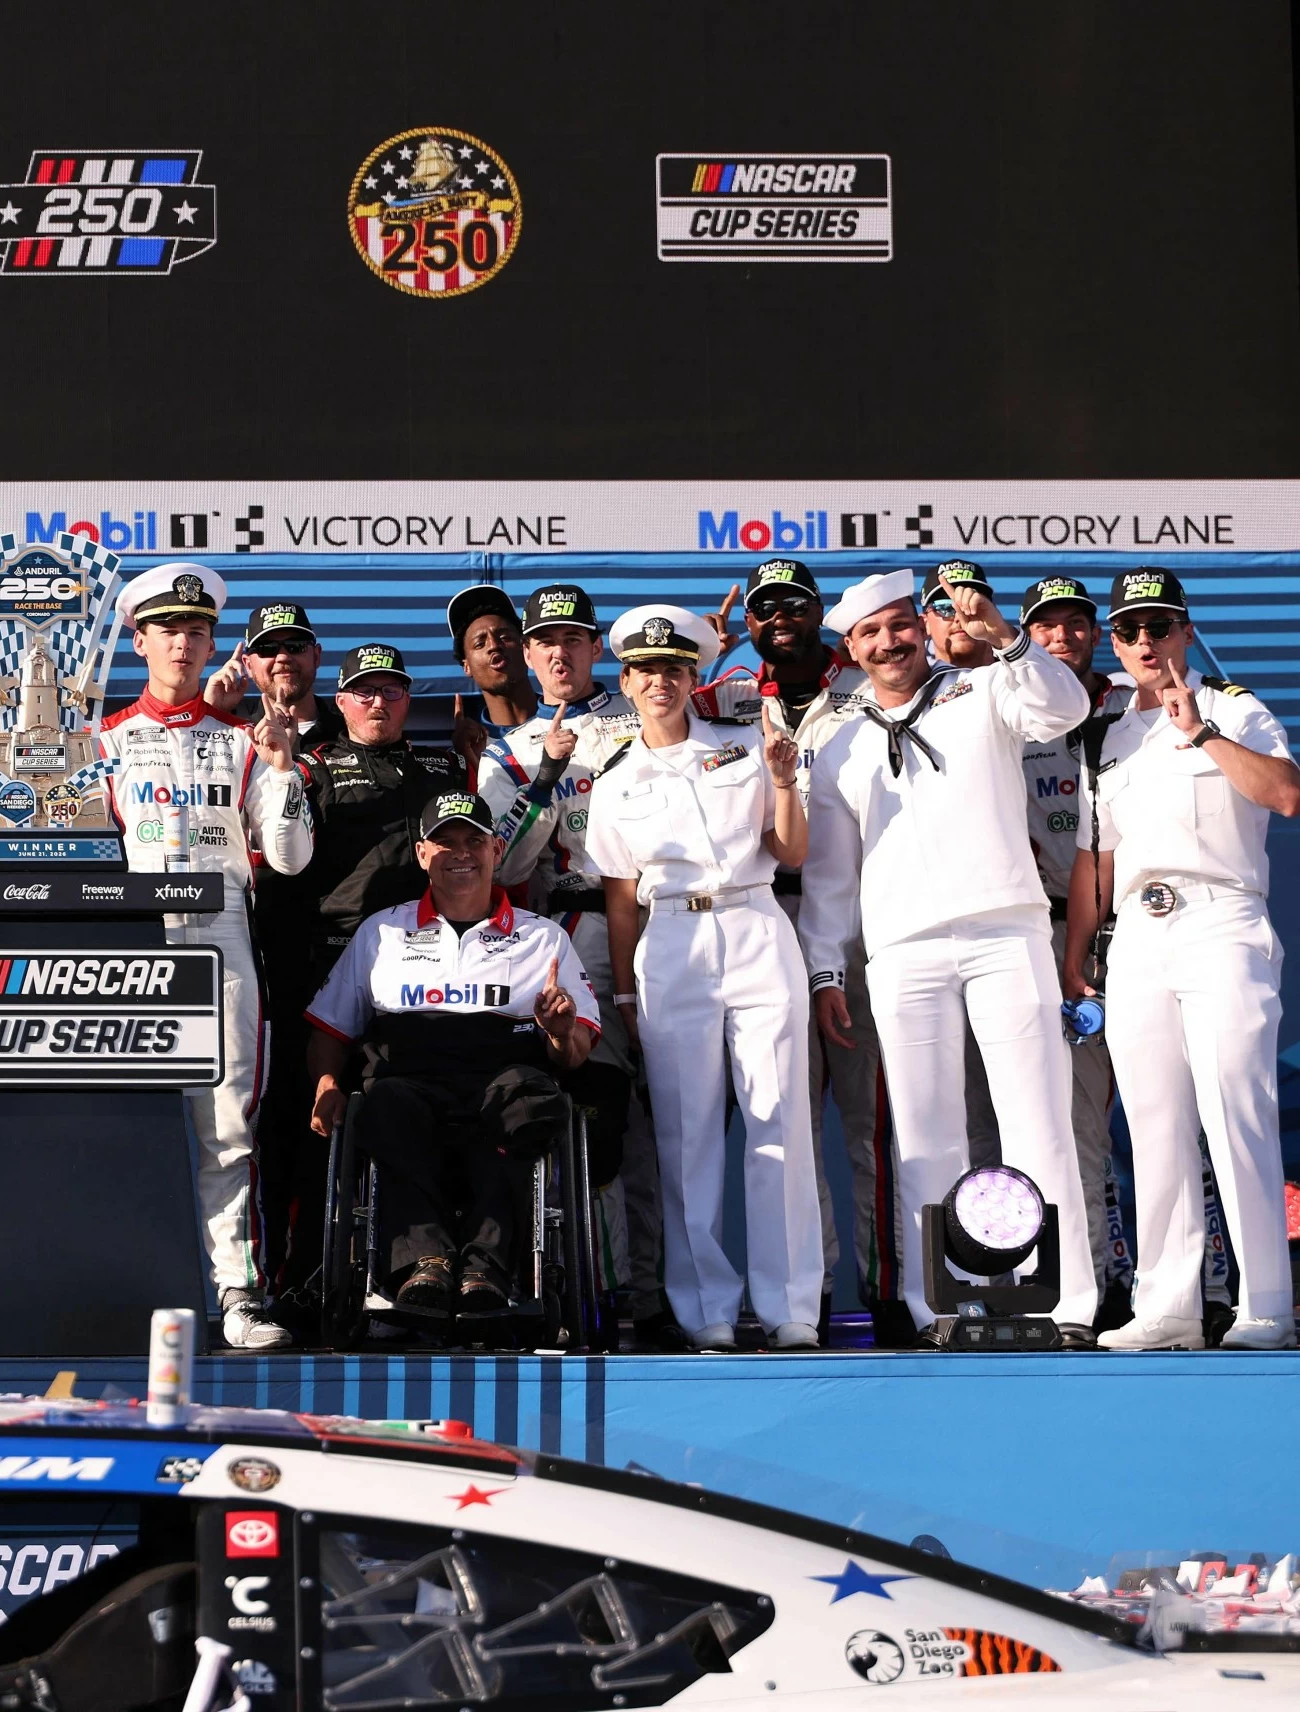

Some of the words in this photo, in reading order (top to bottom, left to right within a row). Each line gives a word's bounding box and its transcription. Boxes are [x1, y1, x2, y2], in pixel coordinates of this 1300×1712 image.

[731, 164, 857, 194] NASCAR
[35, 188, 163, 233] 250
[689, 209, 752, 238] CUP
[753, 209, 860, 238] SERIES
[381, 220, 499, 273] 250
[26, 511, 157, 551] Mobil
[284, 516, 455, 547] VICTORY
[466, 516, 567, 546] LANE
[698, 510, 828, 551] Mobil
[954, 515, 1120, 546] VICTORY
[1133, 515, 1234, 545] LANE
[25, 567, 62, 575] ANDURIL
[758, 560, 796, 576] Anduril
[938, 561, 976, 575] Anduril
[760, 570, 794, 585] 250
[1037, 578, 1077, 592] Anduril
[1122, 572, 1165, 587] Anduril
[0, 578, 77, 601] 250
[1041, 585, 1075, 601] 250
[1124, 583, 1162, 601] 250
[539, 591, 578, 604] Anduril
[260, 603, 297, 618] Anduril
[540, 601, 576, 618] 250
[262, 613, 295, 629] 250
[357, 646, 395, 658] Anduril
[359, 655, 394, 670] 250
[828, 692, 864, 701] TOYOT
[191, 730, 235, 741] TOYOTA
[133, 747, 172, 756] Robinhood
[131, 781, 203, 807] Mobil
[436, 792, 476, 807] Anduril
[51, 803, 78, 817] 250
[437, 801, 474, 818] 250
[202, 826, 226, 835] AUTO
[500, 817, 518, 843] bil
[8, 843, 77, 851] WINNER
[199, 836, 228, 846] PARTS
[555, 874, 583, 888] sparco
[82, 884, 124, 896] Freeway
[154, 884, 203, 900] xfinity
[478, 931, 521, 943] TOYOA
[402, 954, 441, 963] GOODYEAR
[21, 960, 175, 995] NASCAR
[400, 984, 477, 1007] Mobil
[49, 1019, 183, 1054] SERIES
[1205, 1201, 1227, 1277] Mobil
[228, 1617, 276, 1630] CELSIUS
[904, 1628, 941, 1642] San
[911, 1644, 966, 1660] Diego
[914, 1660, 955, 1675] Zoo
